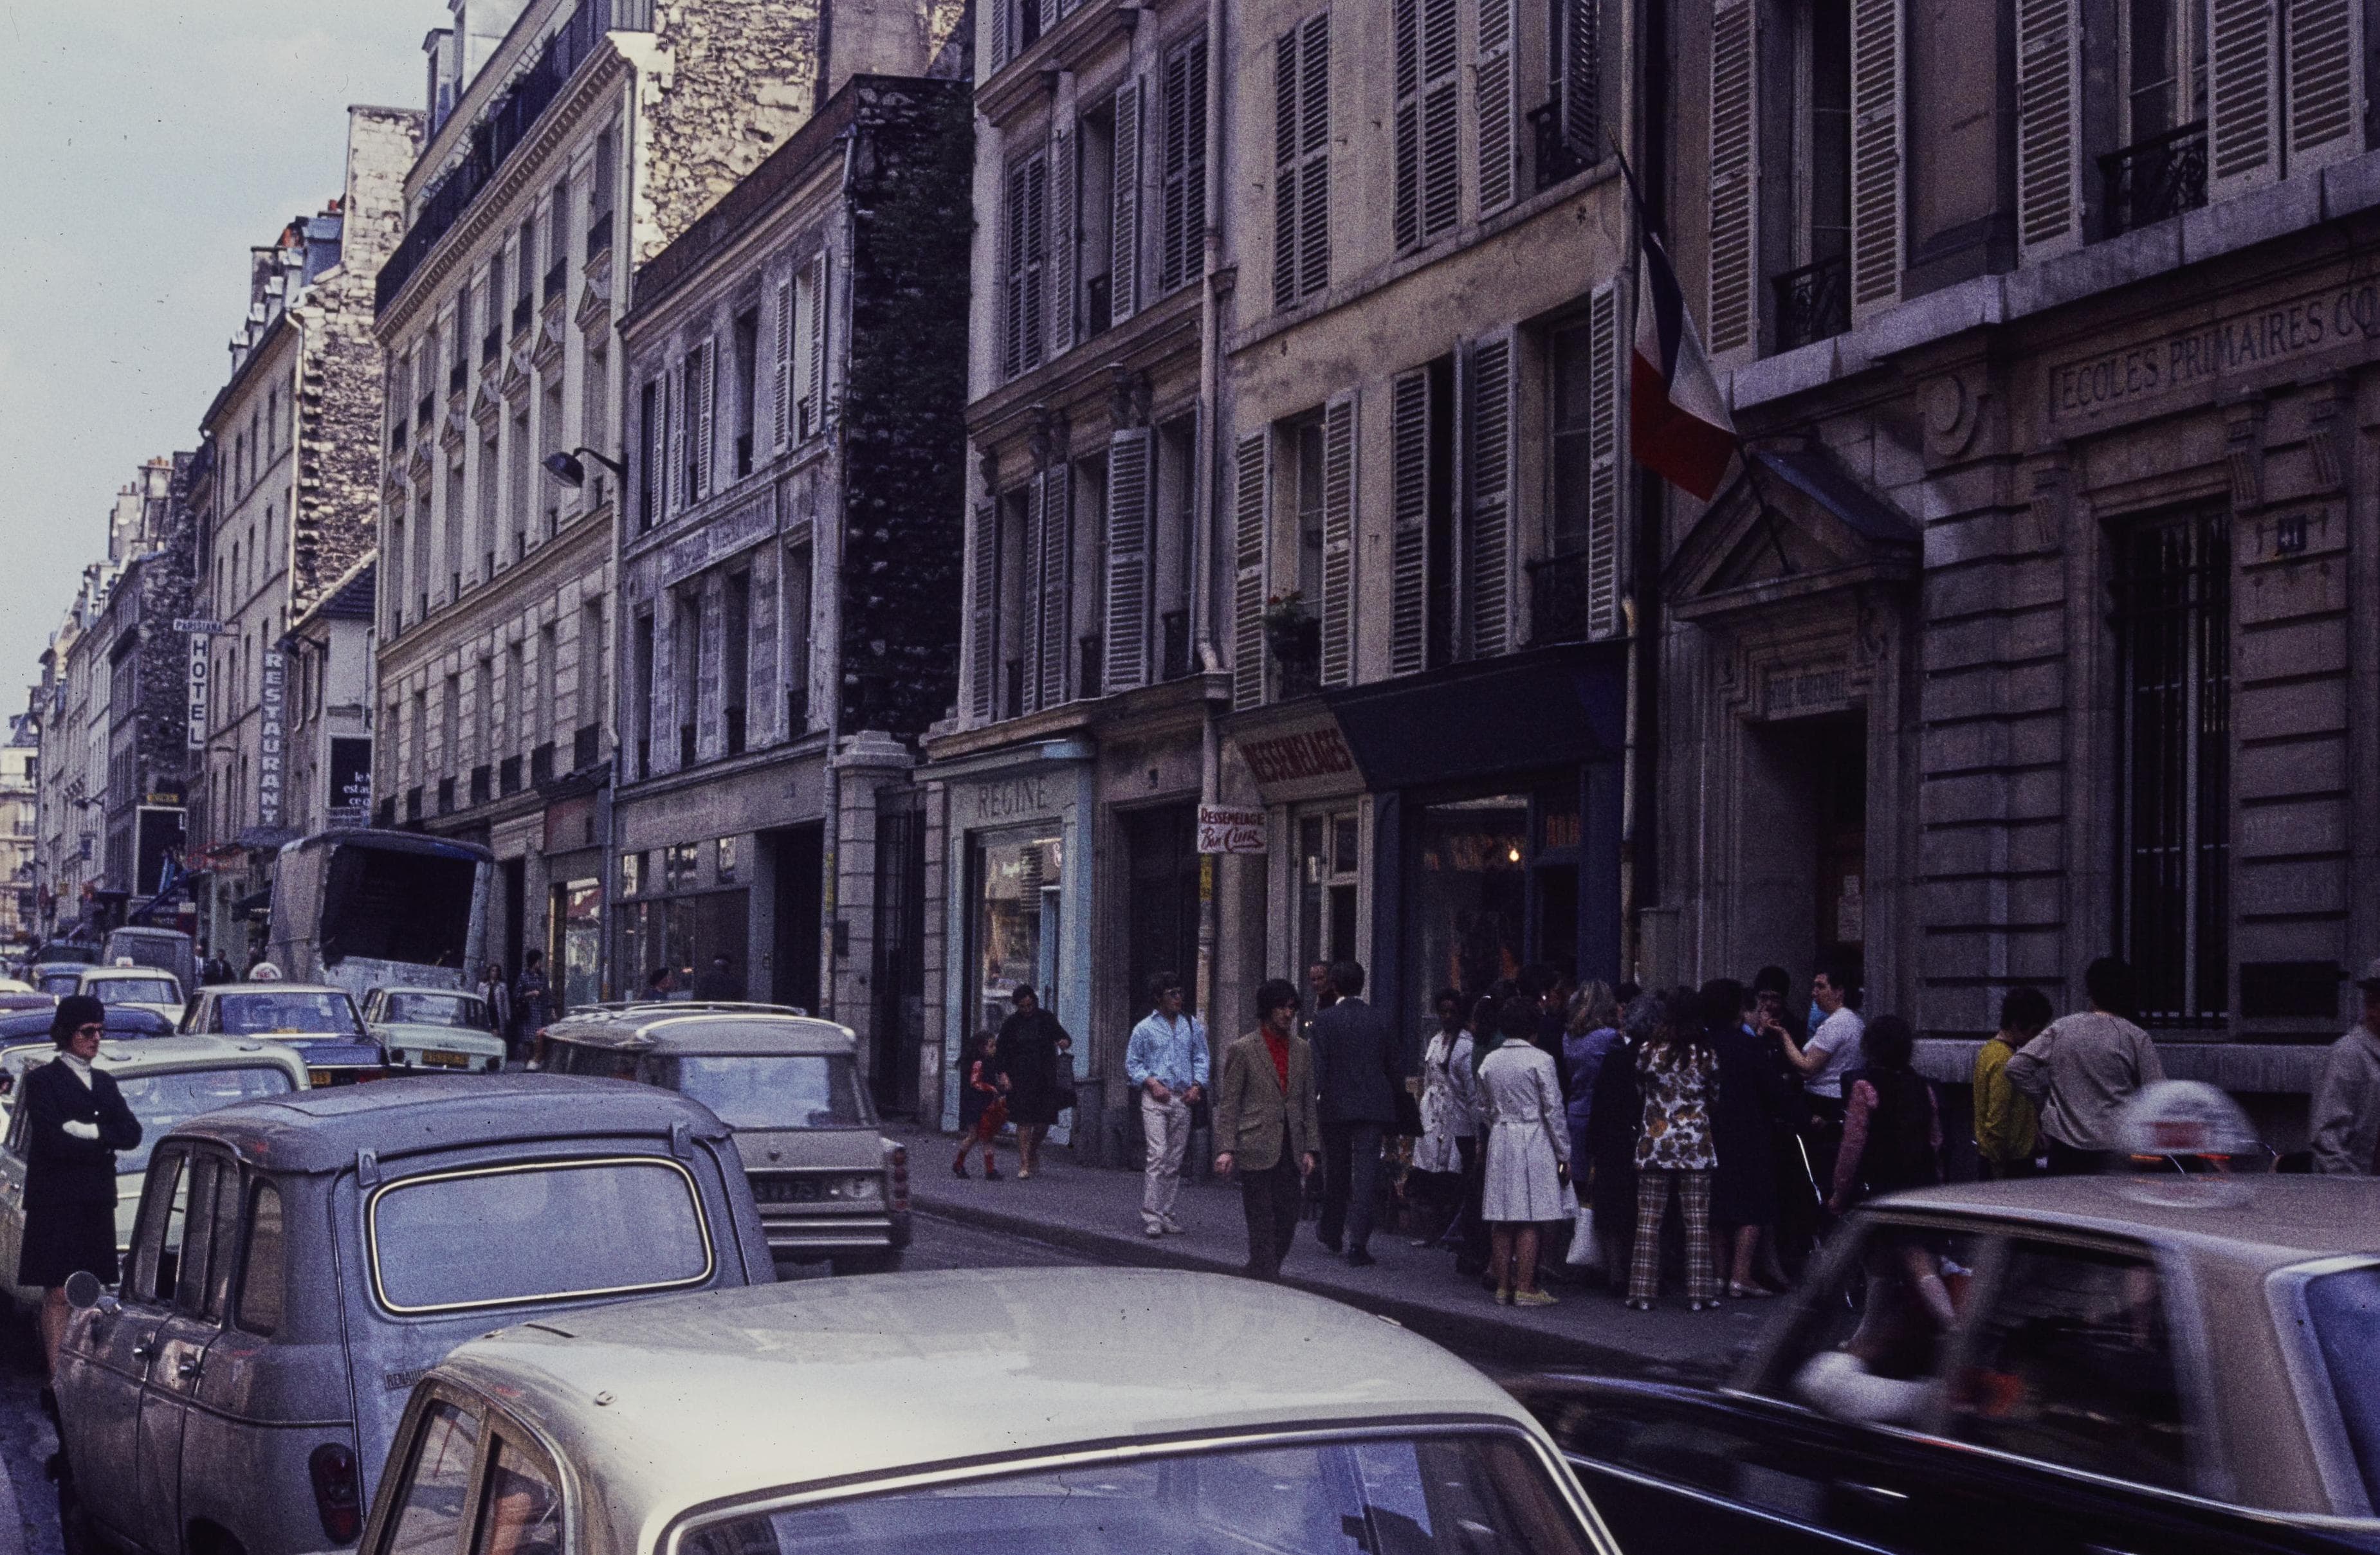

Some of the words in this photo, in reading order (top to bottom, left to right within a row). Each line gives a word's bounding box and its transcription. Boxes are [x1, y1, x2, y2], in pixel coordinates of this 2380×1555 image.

[2060, 348, 2159, 410] ECOLES
[2169, 300, 2325, 384] PRIMAIRES
[190, 640, 207, 745] HOTEL
[261, 653, 283, 824] RESTAURANT
[1241, 727, 1354, 784] RESSEMELAGES
[977, 776, 1050, 818] REGINE
[1200, 808, 1265, 826] RESSEMELAGE
